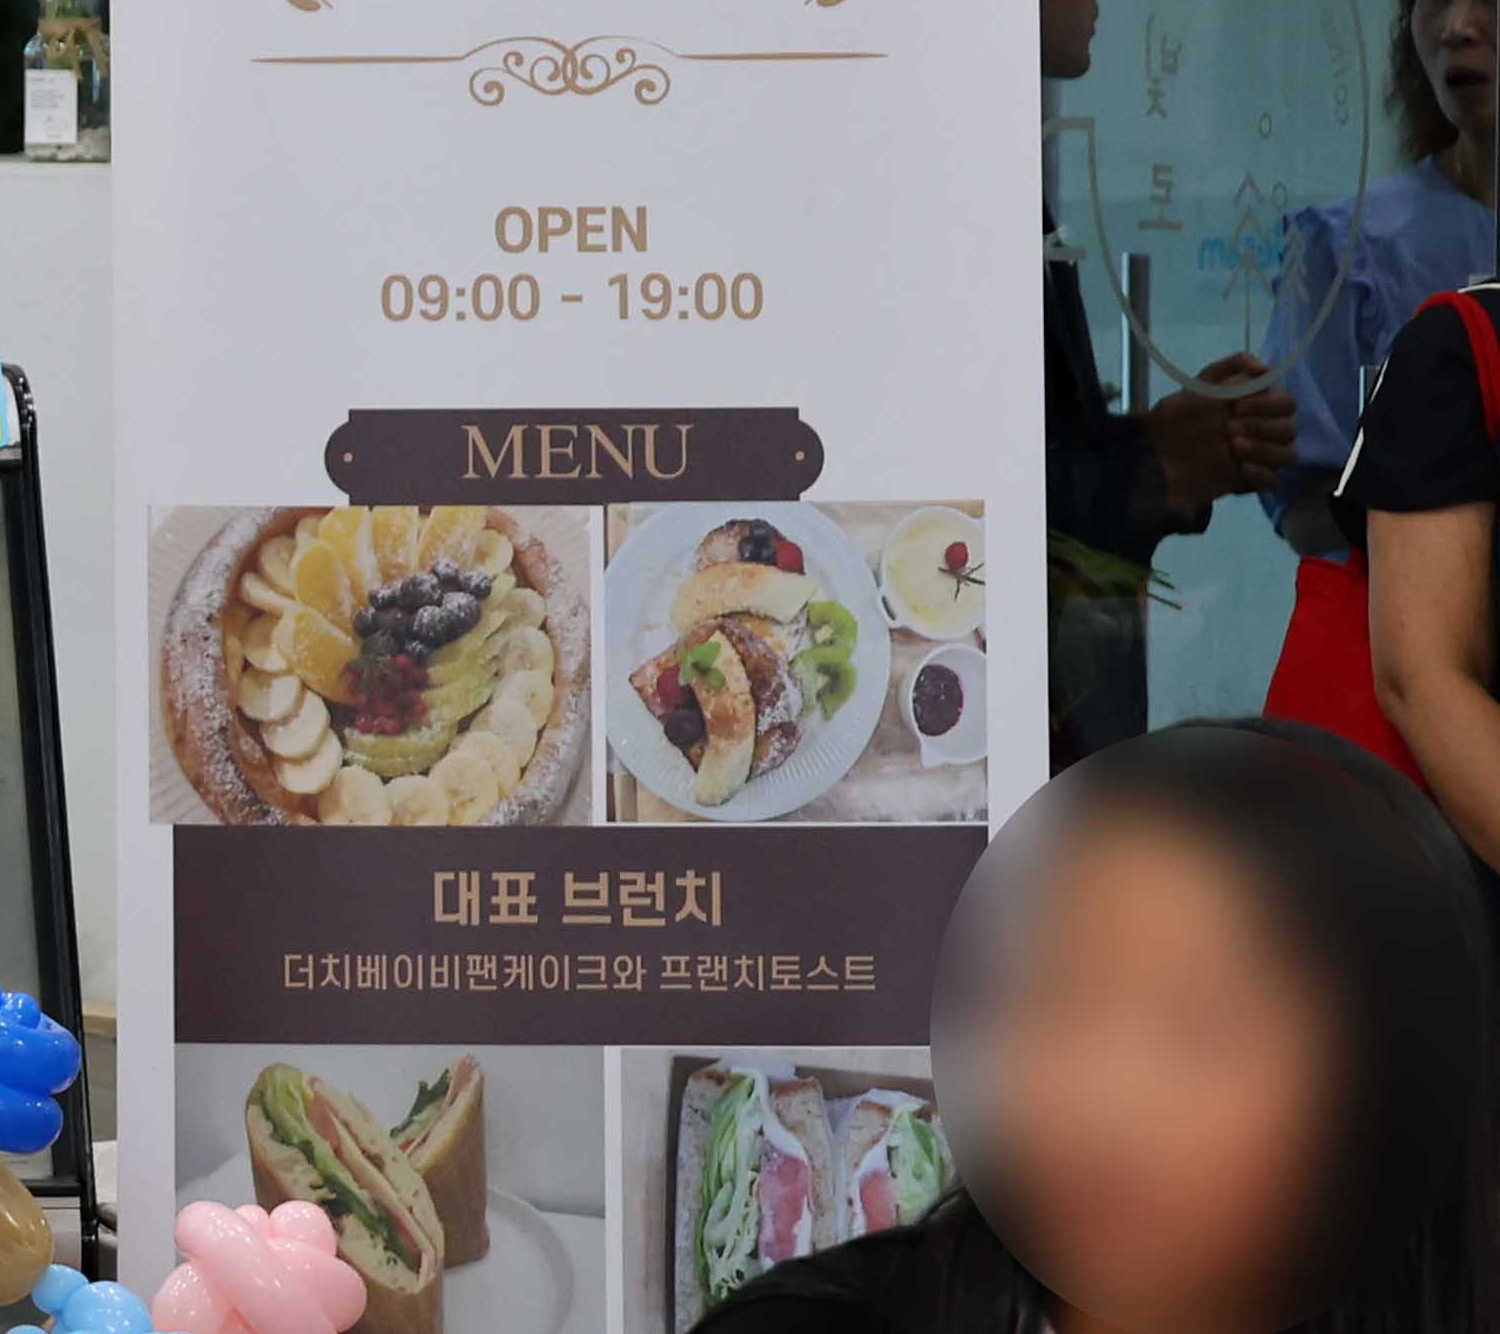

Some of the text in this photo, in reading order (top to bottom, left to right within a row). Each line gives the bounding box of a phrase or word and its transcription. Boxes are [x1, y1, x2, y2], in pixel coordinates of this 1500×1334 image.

[494, 206, 649, 254] OPEN
[381, 273, 541, 322] 09:00
[607, 273, 765, 321] 19:00
[461, 423, 694, 480] MENU
[433, 869, 723, 927] 대표 브런치
[283, 953, 876, 992] 더치베이비팬케이크와 프랜치토스트
